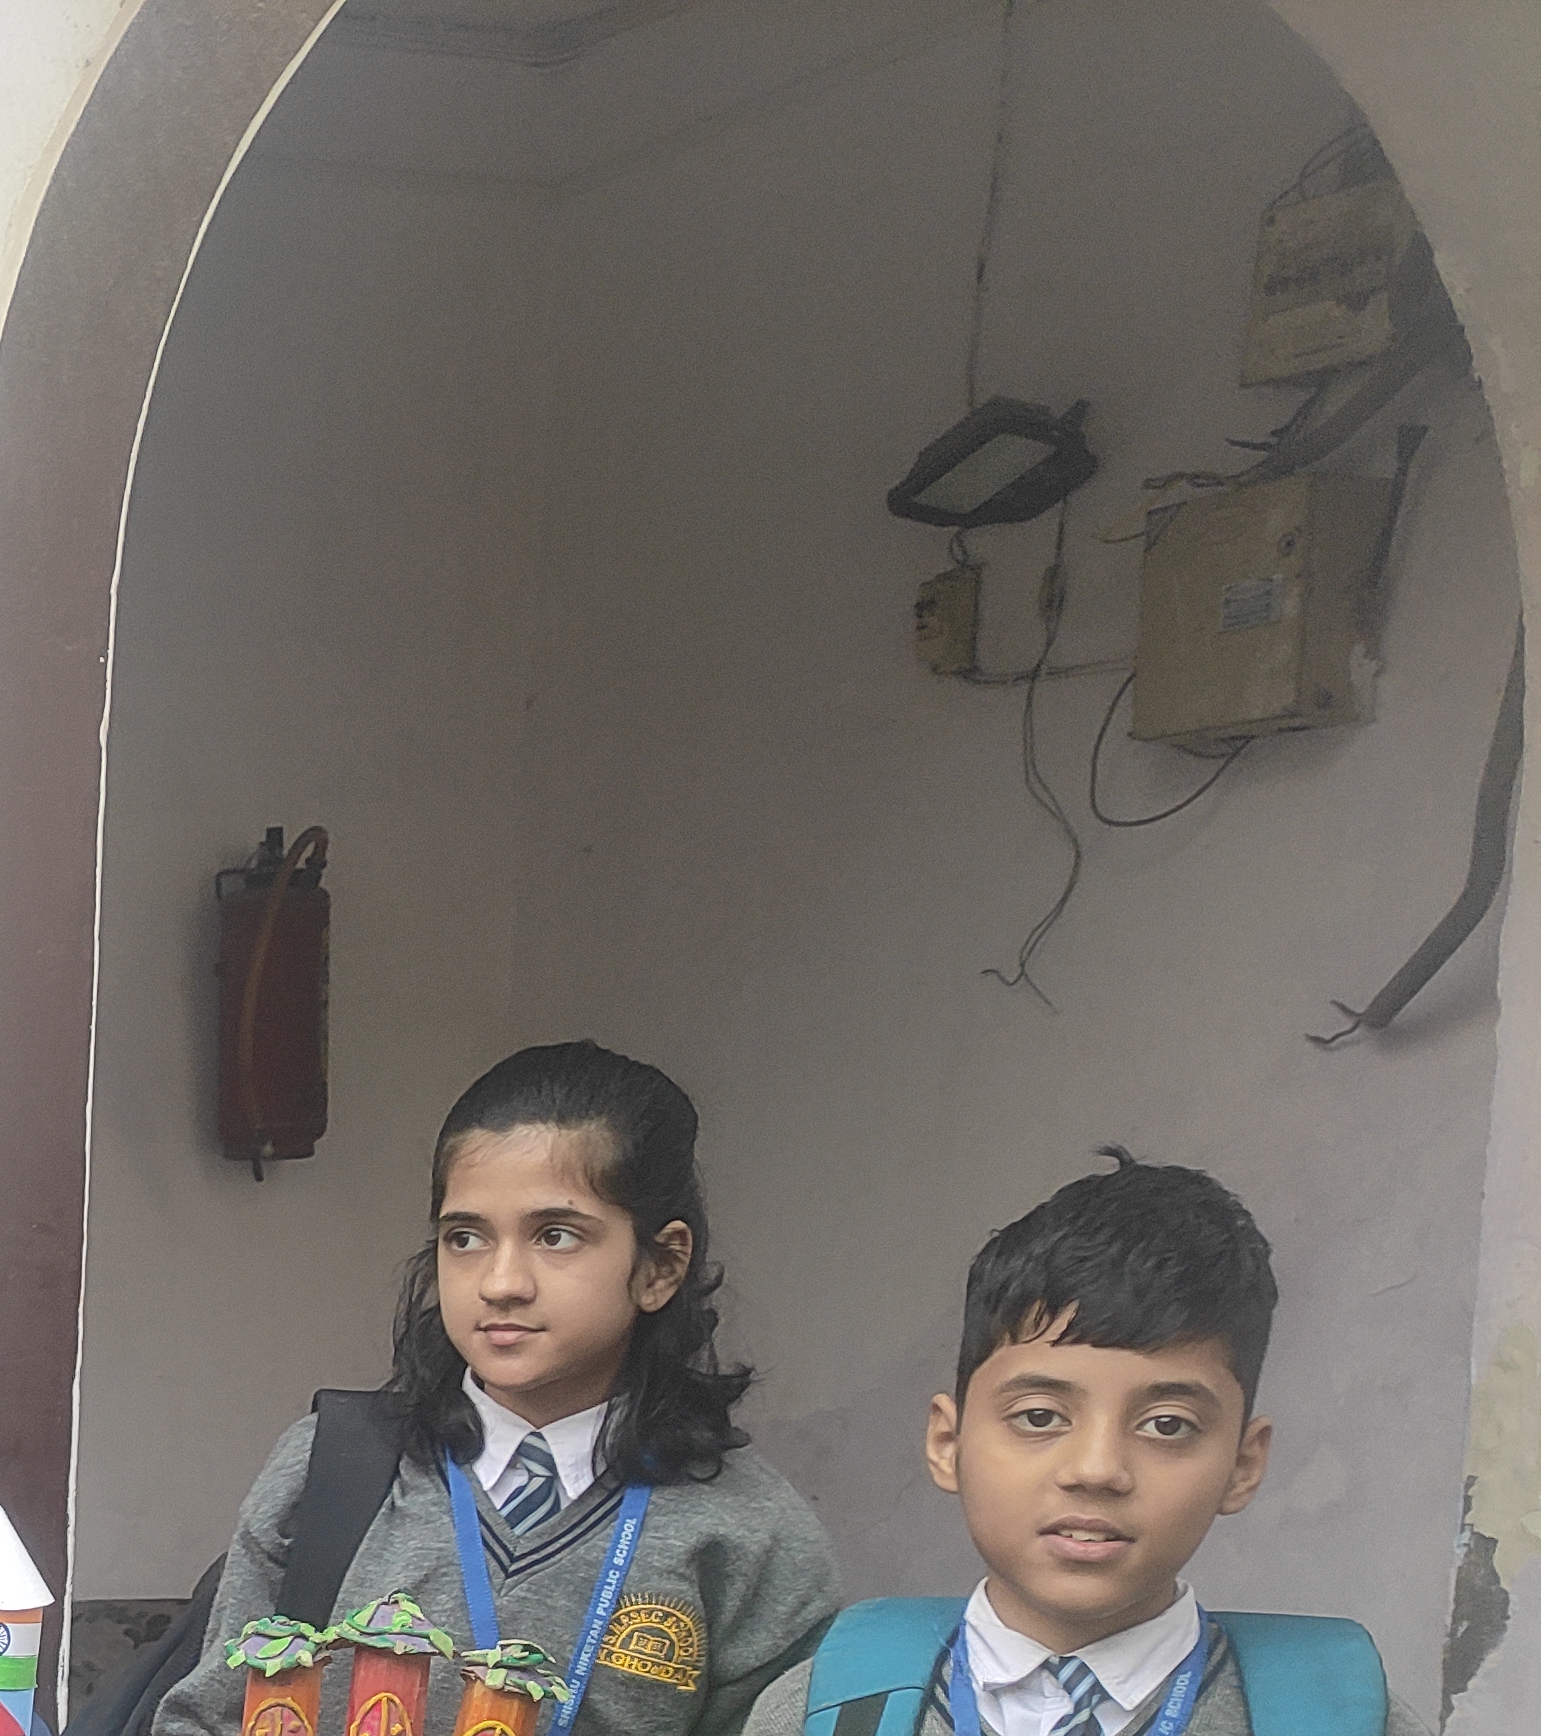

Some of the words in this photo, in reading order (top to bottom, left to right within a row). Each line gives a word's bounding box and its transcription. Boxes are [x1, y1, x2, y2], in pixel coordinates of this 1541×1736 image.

[575, 1618, 604, 1677] NIKETAN
[596, 1568, 621, 1617] PUBLIC
[613, 1516, 638, 1567] SCHOOL
